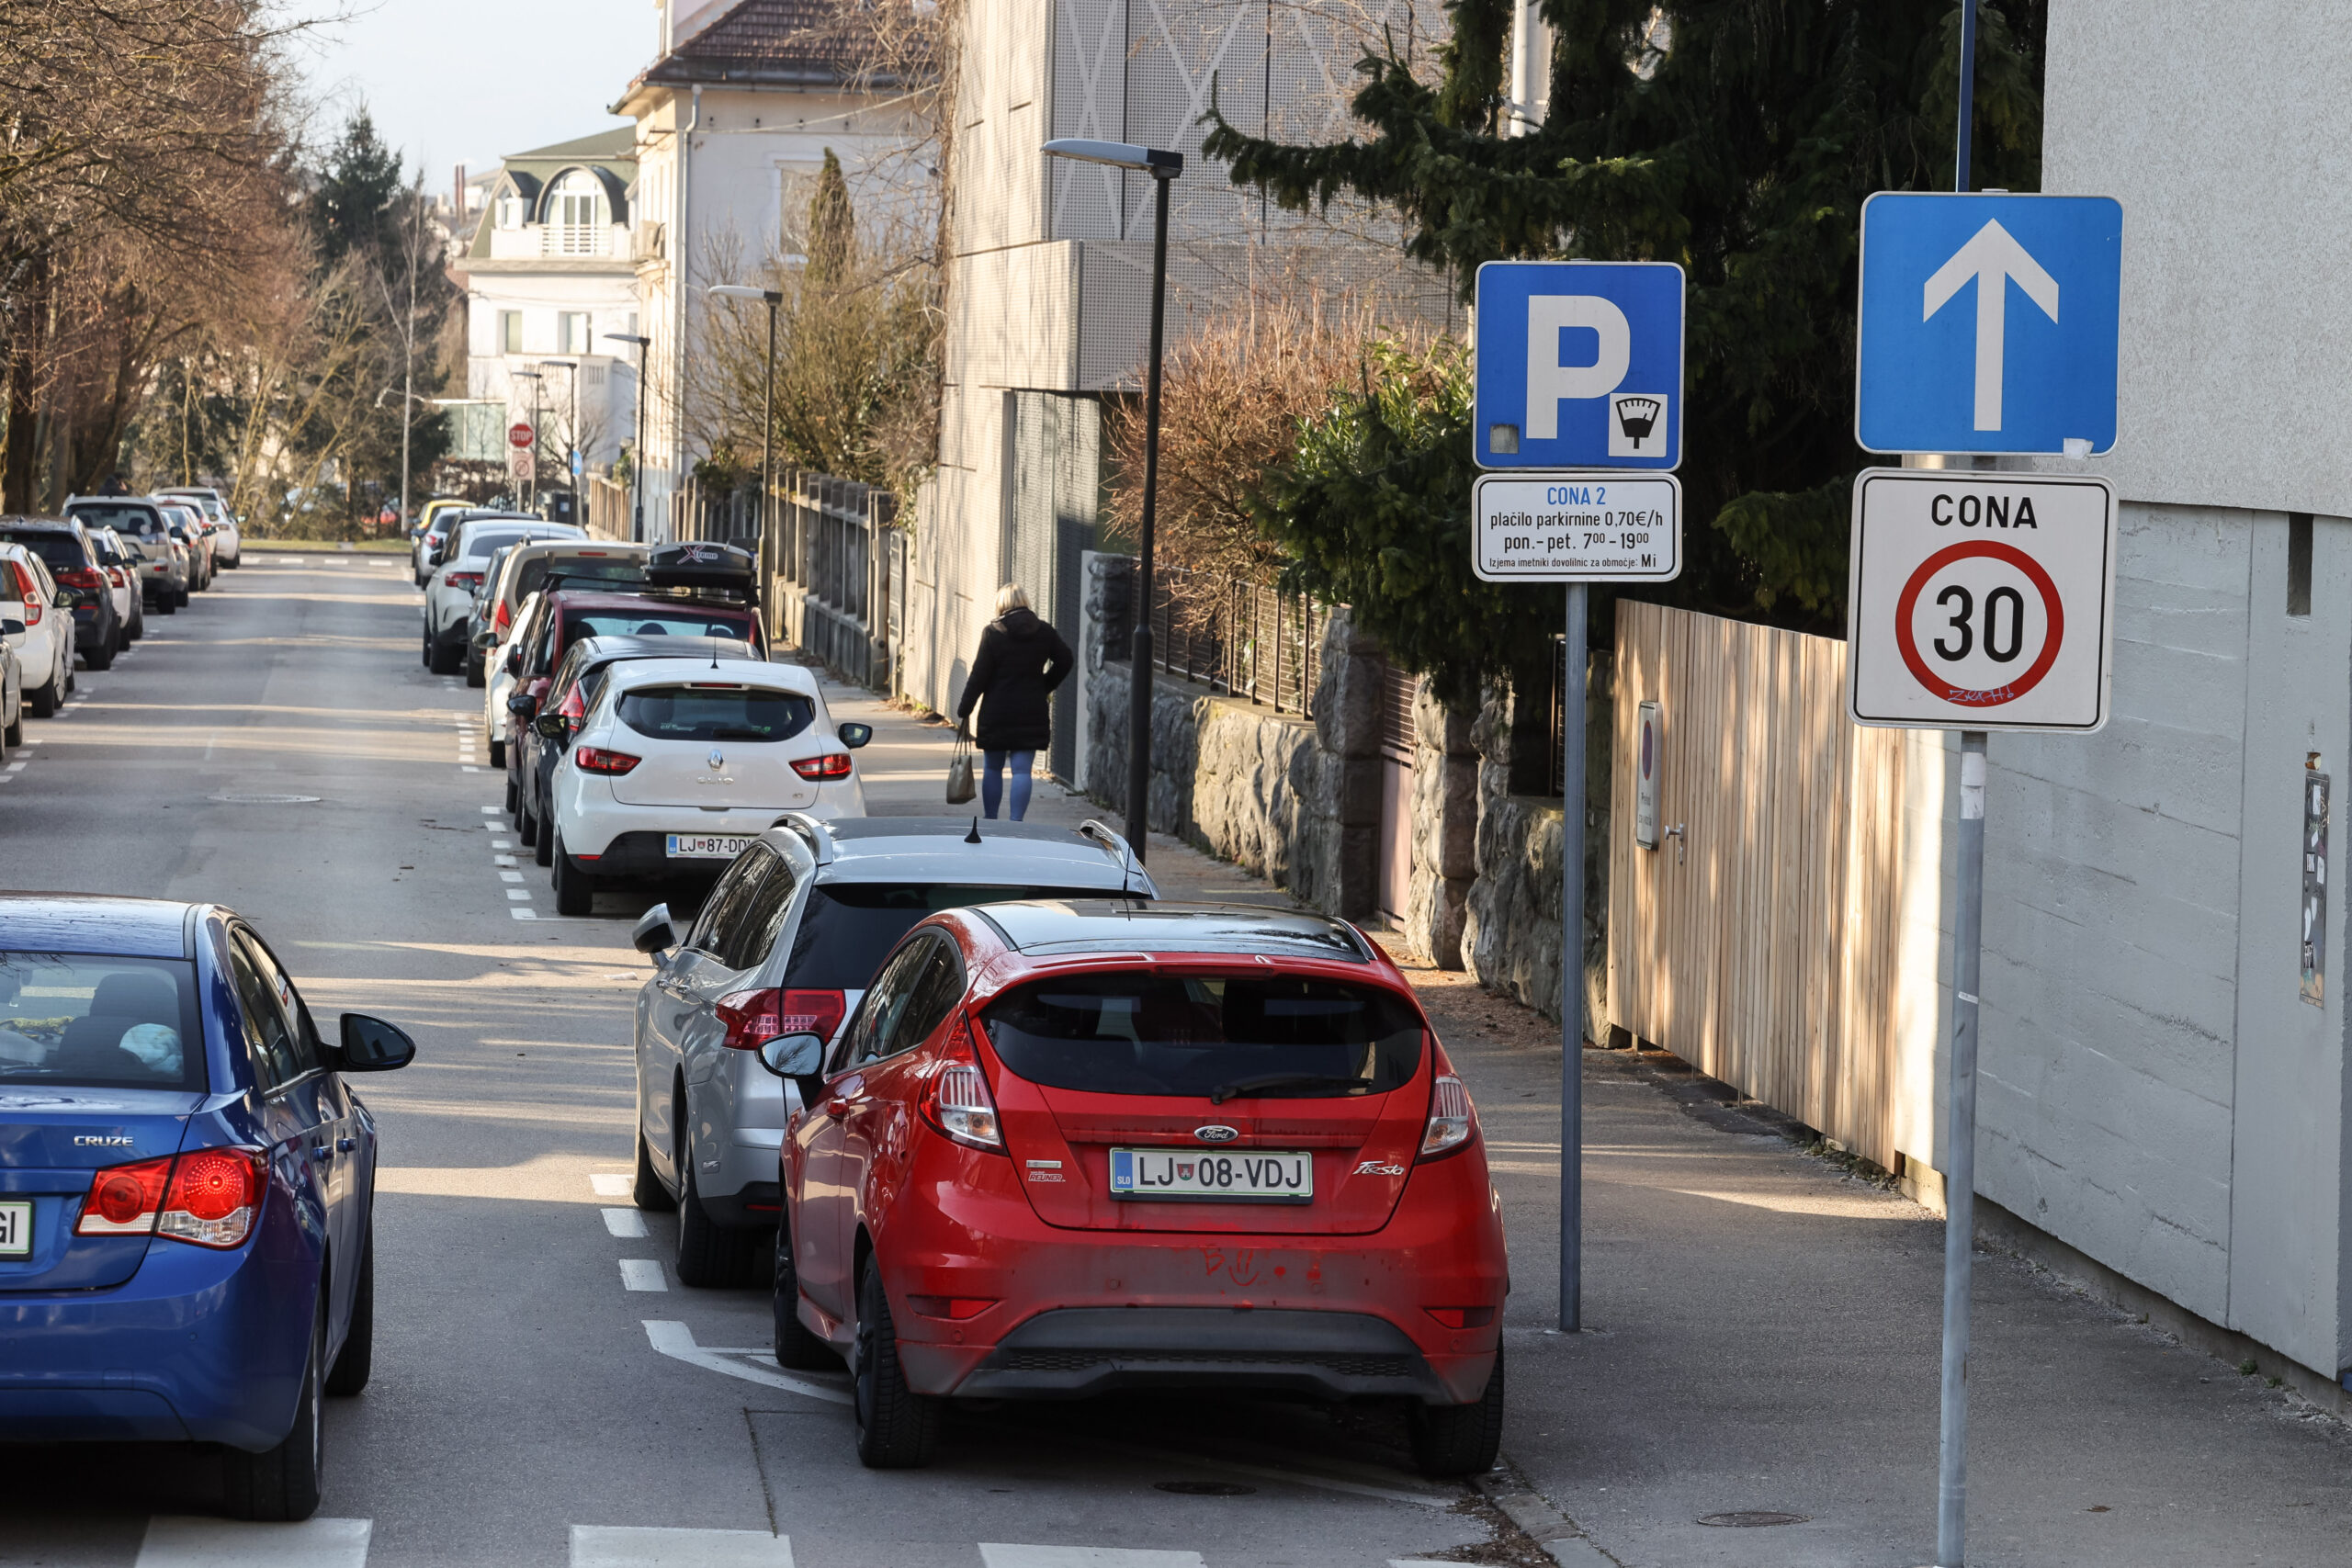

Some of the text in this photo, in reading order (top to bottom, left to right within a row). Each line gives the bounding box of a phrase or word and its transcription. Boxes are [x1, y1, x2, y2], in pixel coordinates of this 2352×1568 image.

[1526, 295, 1631, 439] P
[510, 430, 531, 441] STOP
[1547, 487, 1606, 505] CONA 2
[1931, 493, 2038, 529] CONA
[1490, 509, 1663, 530] plačilo parkirnine 0,70€/h
[1547, 533, 1577, 554] pet.
[1489, 558, 1516, 569] Izjema
[1518, 558, 1549, 567] imetniki
[1551, 558, 1588, 567] dovolilnic
[1601, 558, 1638, 569] območje:
[1933, 585, 2024, 663] 30
[679, 838, 751, 853] LJ 87-DD
[74, 1135, 134, 1146] CRUZE
[1204, 1128, 1229, 1139] Ford
[1139, 1156, 1302, 1189] LJ 08-VDJ
[1352, 1160, 1405, 1175] Fiesta
[1116, 1177, 1131, 1185] SLO
